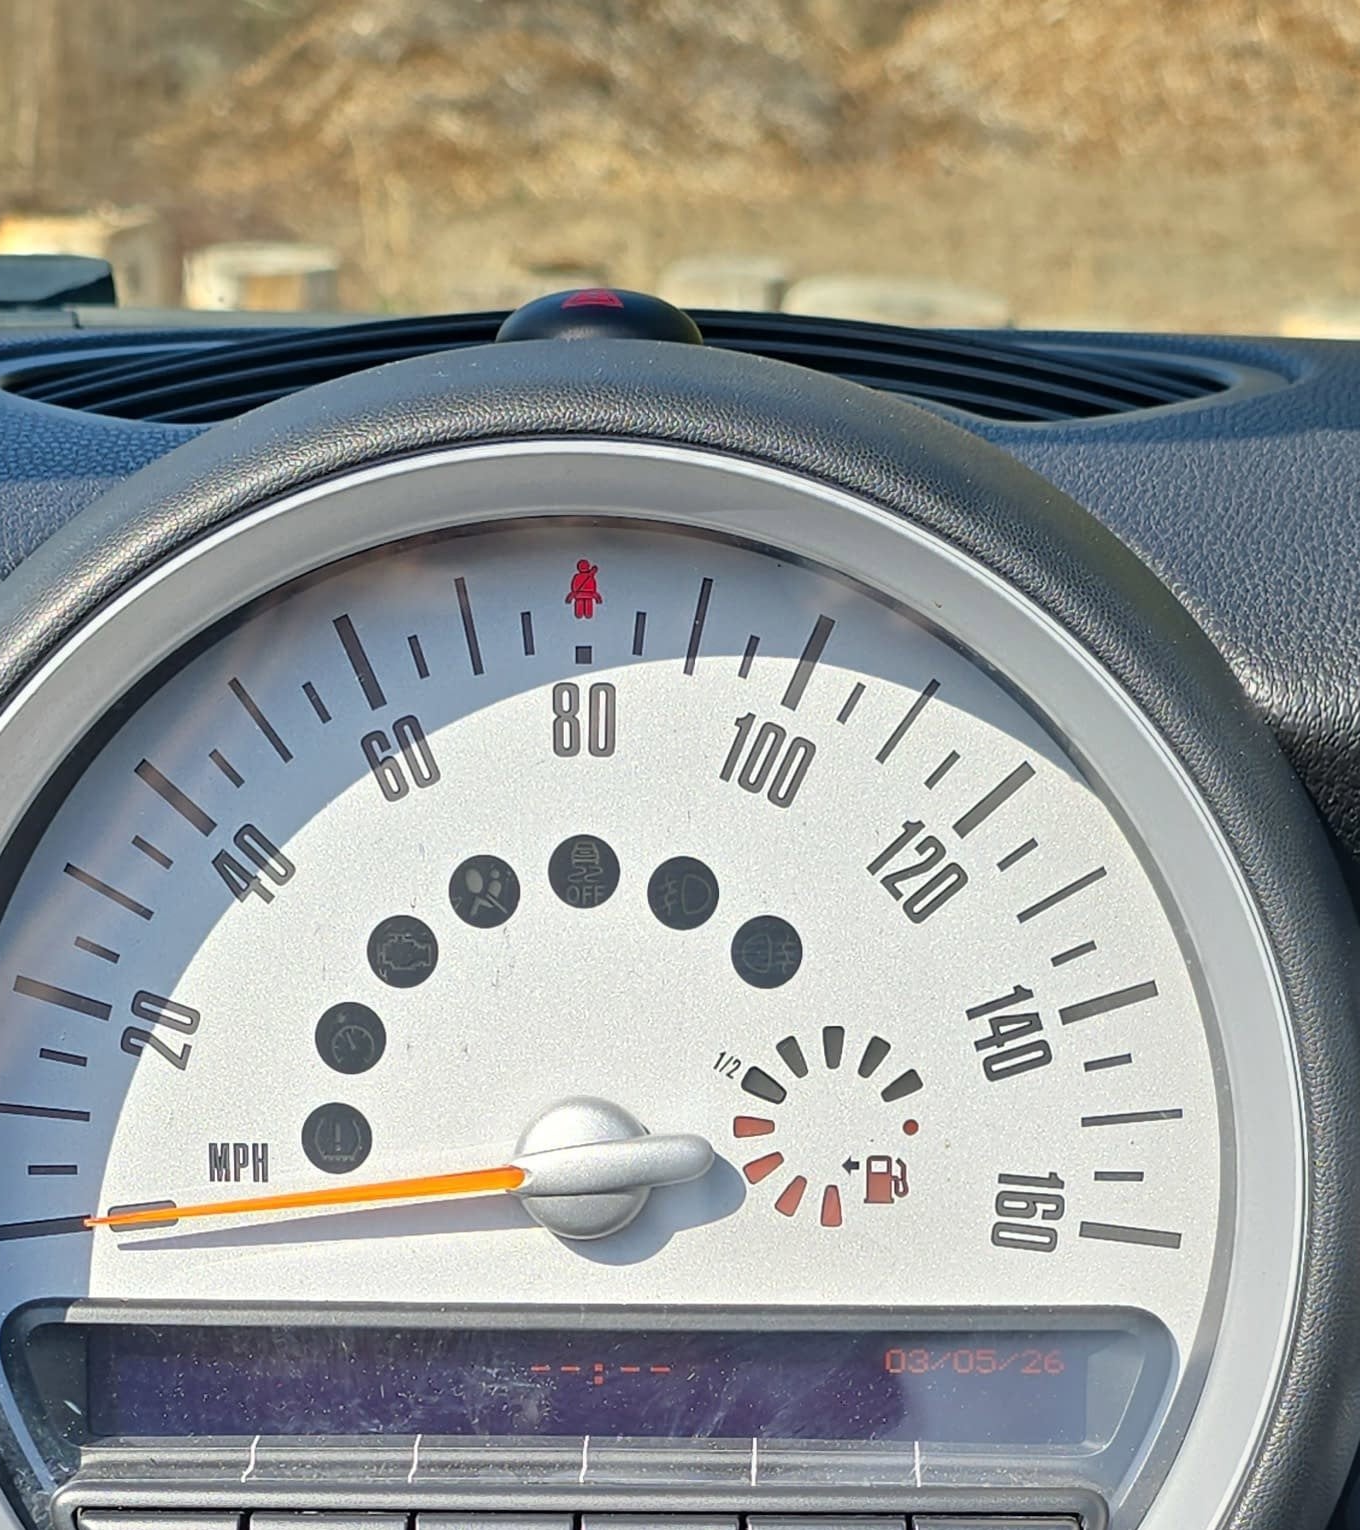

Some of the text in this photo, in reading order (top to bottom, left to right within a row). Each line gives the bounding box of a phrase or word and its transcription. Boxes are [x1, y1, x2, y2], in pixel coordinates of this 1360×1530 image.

[360, 714, 441, 802] 60
[552, 682, 617, 758] 80
[719, 711, 816, 808] 100
[212, 823, 296, 904] 40
[566, 884, 607, 905] OFF
[866, 819, 969, 924] 120
[120, 989, 201, 1071] 20
[713, 1051, 742, 1079] 1/2
[965, 984, 1053, 1082] 140
[208, 1142, 269, 1183] MPH
[990, 1171, 1065, 1252] 160
[884, 1348, 1065, 1375] 03/05/26
